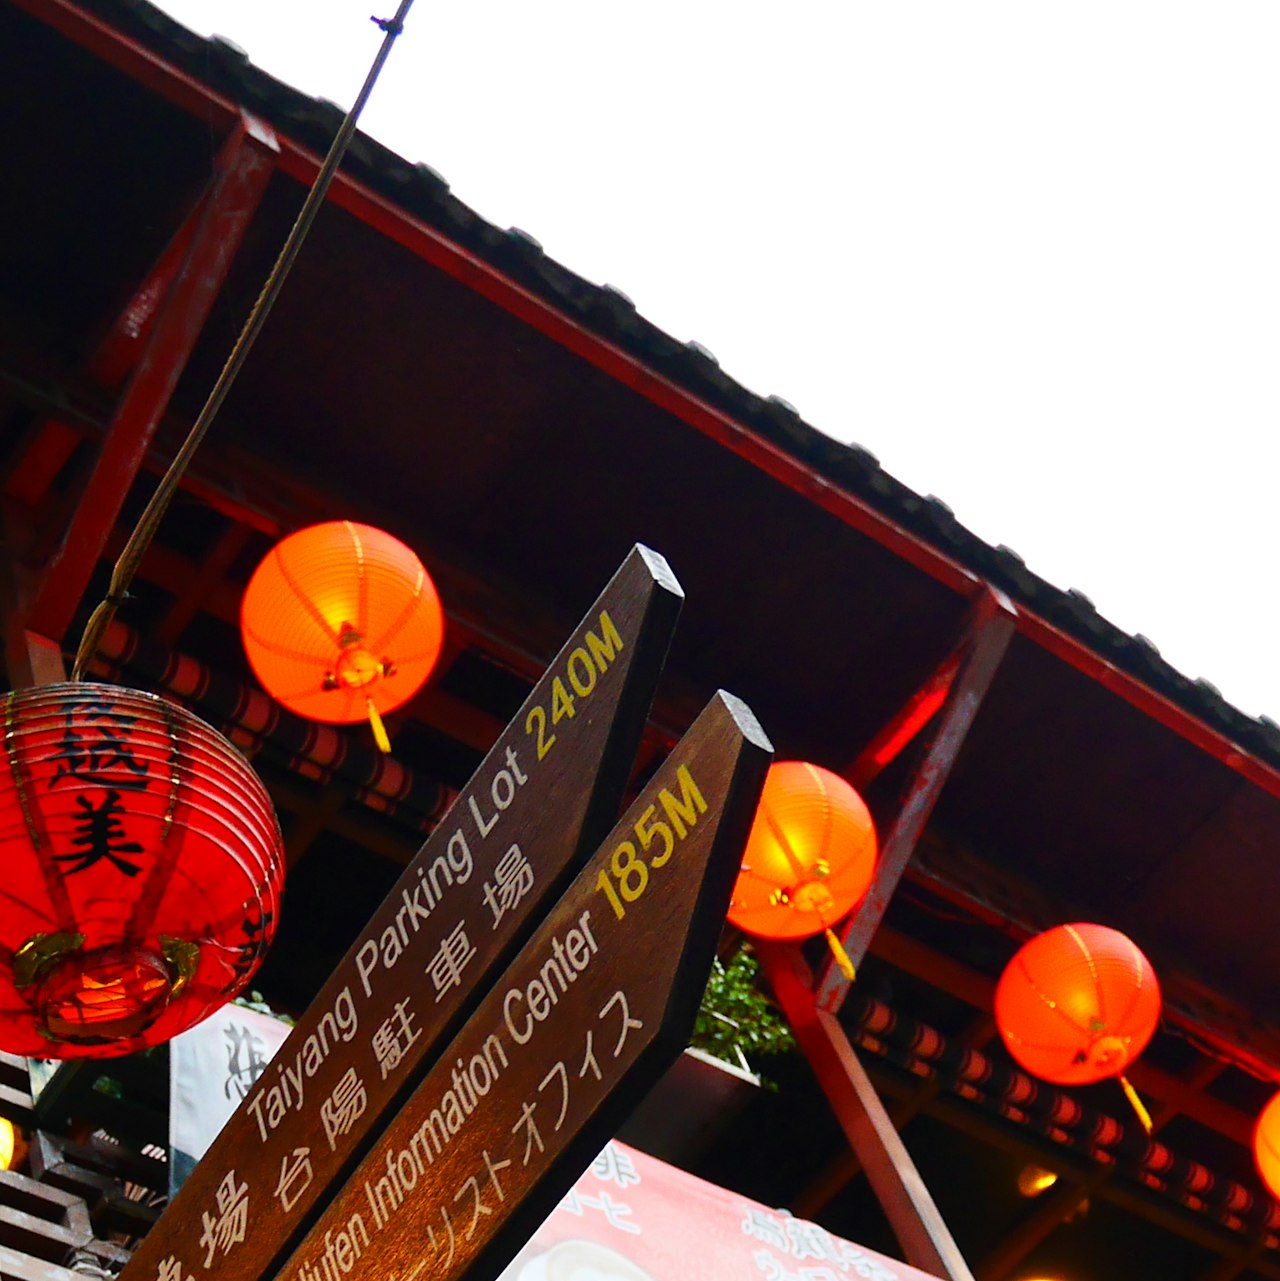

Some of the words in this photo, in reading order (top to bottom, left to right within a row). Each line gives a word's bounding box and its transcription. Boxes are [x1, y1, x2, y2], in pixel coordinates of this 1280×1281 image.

[247, 985, 358, 1142] Taiyang
[355, 829, 474, 998] Parking
[468, 745, 529, 839] Lot
[522, 608, 626, 762] 240M
[274, 843, 535, 1214] 台陽駐車場
[364, 1034, 509, 1233] Information
[503, 910, 599, 1045] Center
[595, 764, 708, 920] 185M
